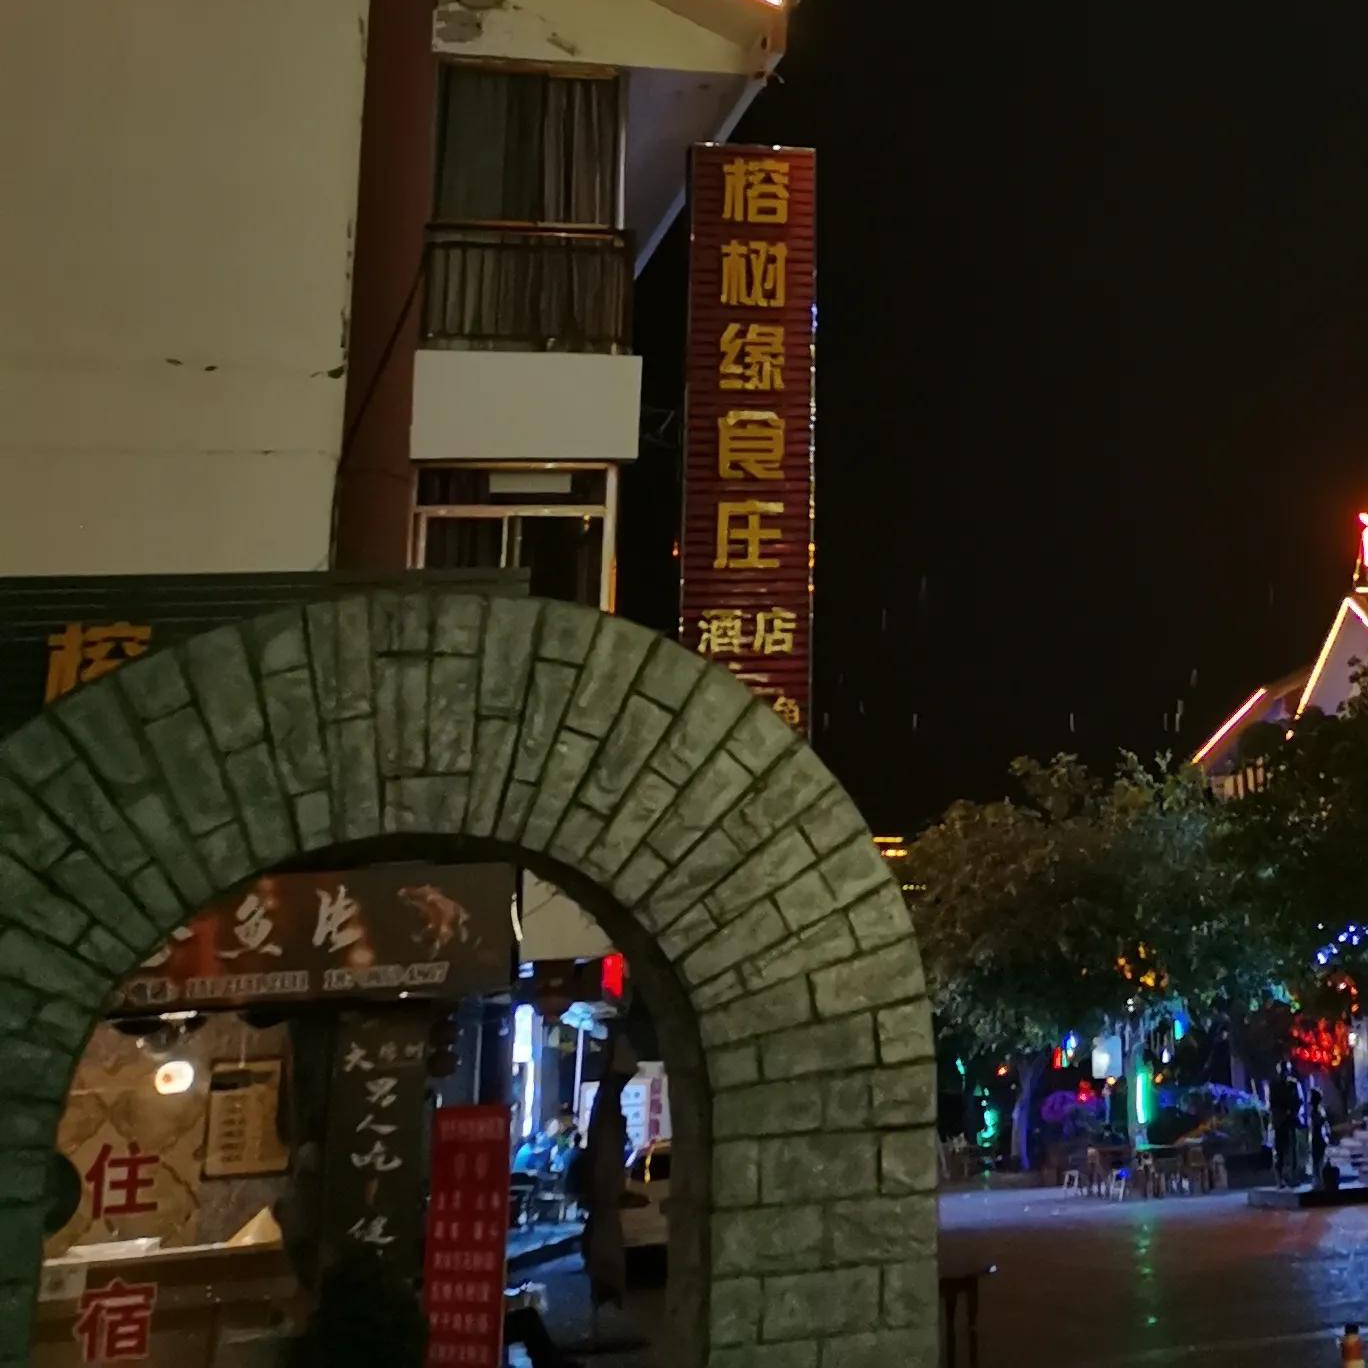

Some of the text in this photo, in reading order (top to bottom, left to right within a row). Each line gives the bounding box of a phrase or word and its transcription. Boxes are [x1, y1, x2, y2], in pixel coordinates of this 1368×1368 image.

[712, 158, 790, 569] 榕树缘食庄
[698, 606, 797, 654] 酒店
[73, 1140, 160, 1362] 住宿
